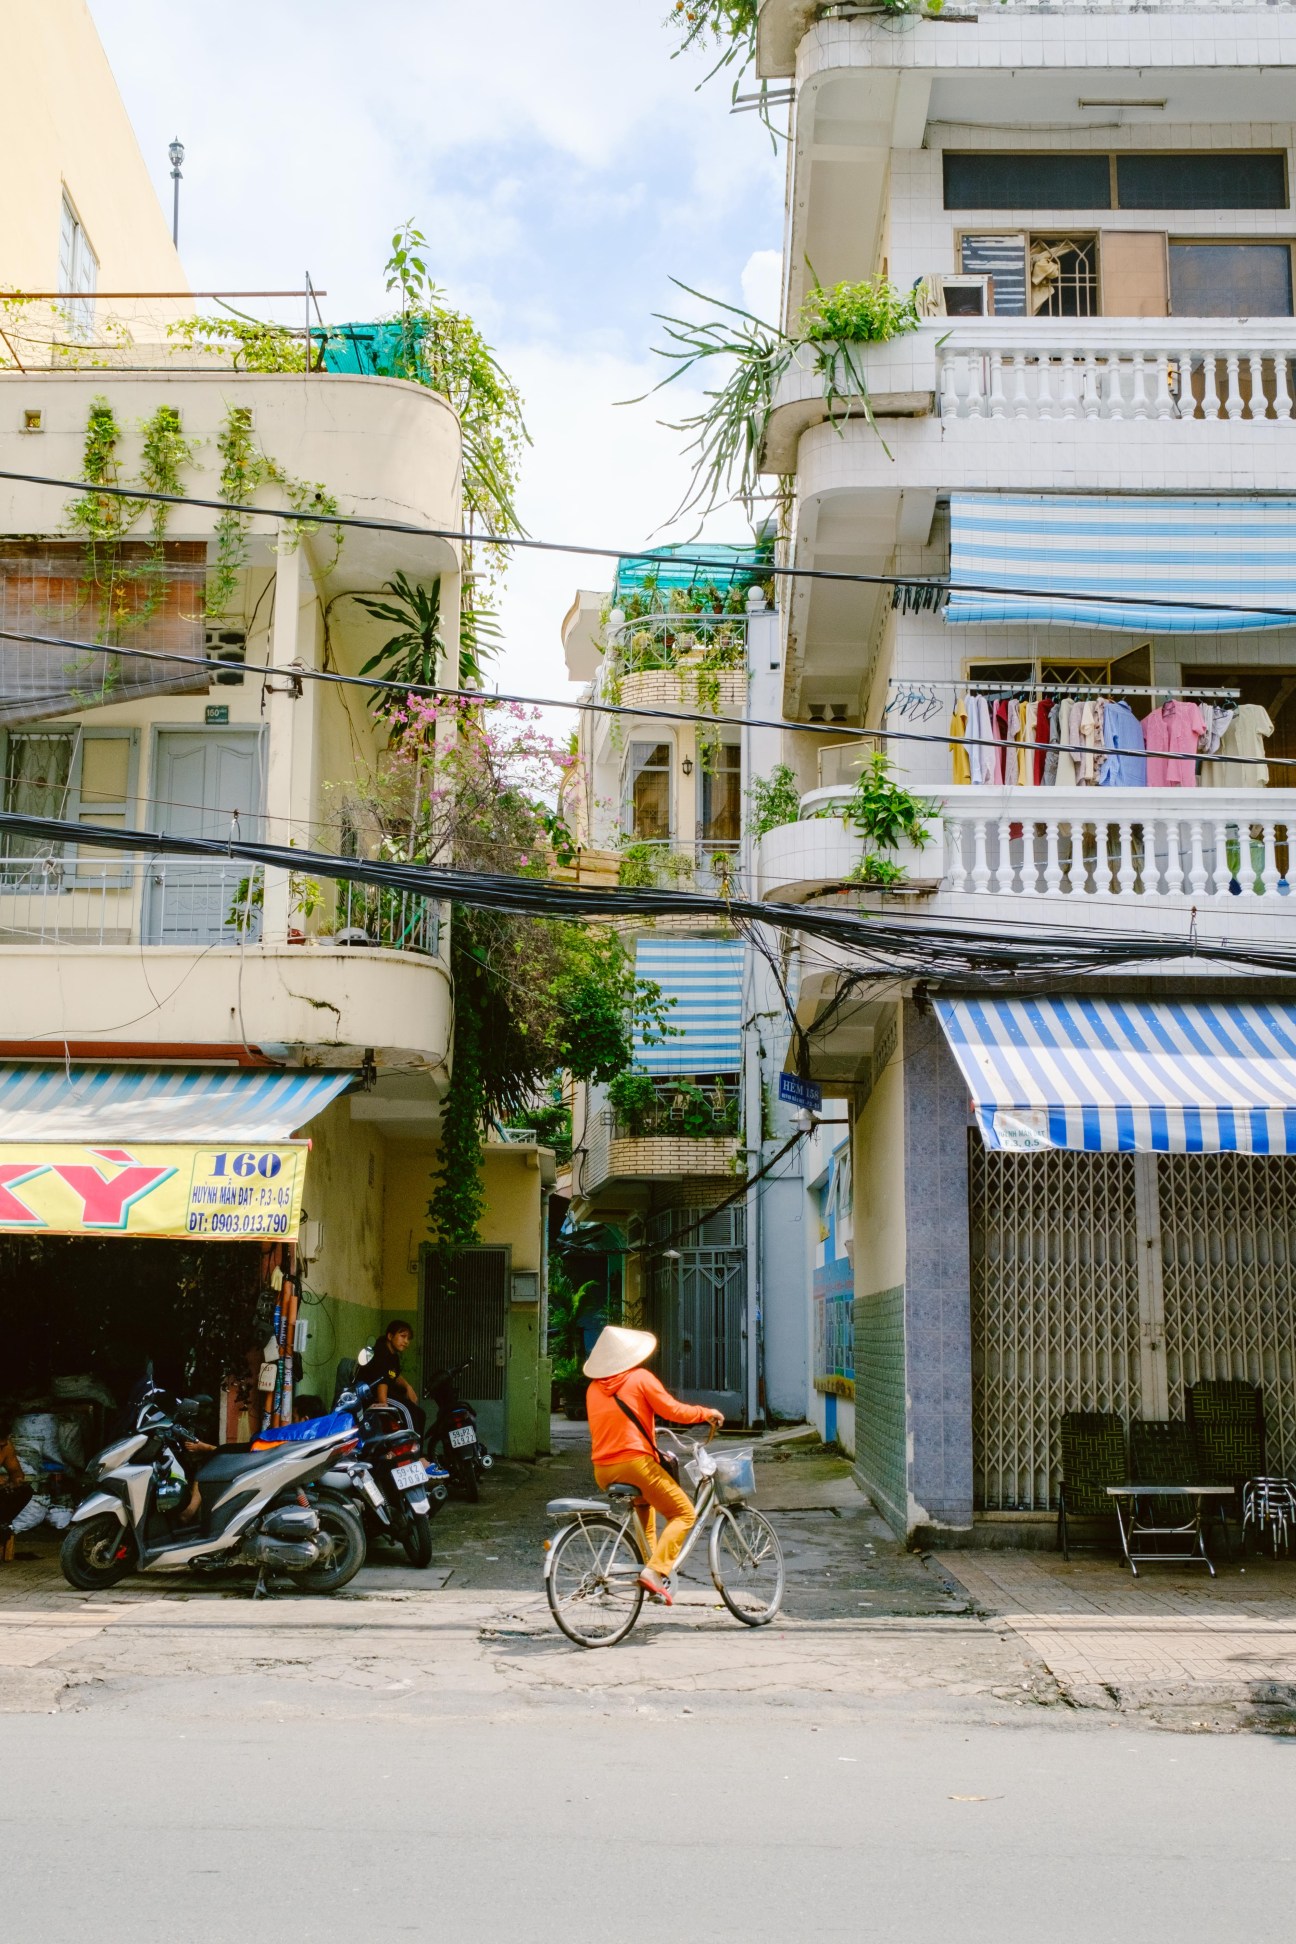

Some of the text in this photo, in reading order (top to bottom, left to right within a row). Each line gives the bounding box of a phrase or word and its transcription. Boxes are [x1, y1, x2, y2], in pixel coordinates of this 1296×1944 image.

[207, 709, 220, 717] 160
[806, 1088, 819, 1101] 158
[1024, 1139, 1040, 1148] Q.5
[208, 1153, 282, 1178] 160
[192, 1181, 218, 1204] HUỲNH
[238, 1187, 254, 1210] ĐẠT
[260, 1188, 273, 1206] P.3
[277, 1187, 290, 1208] Q.5
[189, 1212, 288, 1234] ĐT: 0903.013.790
